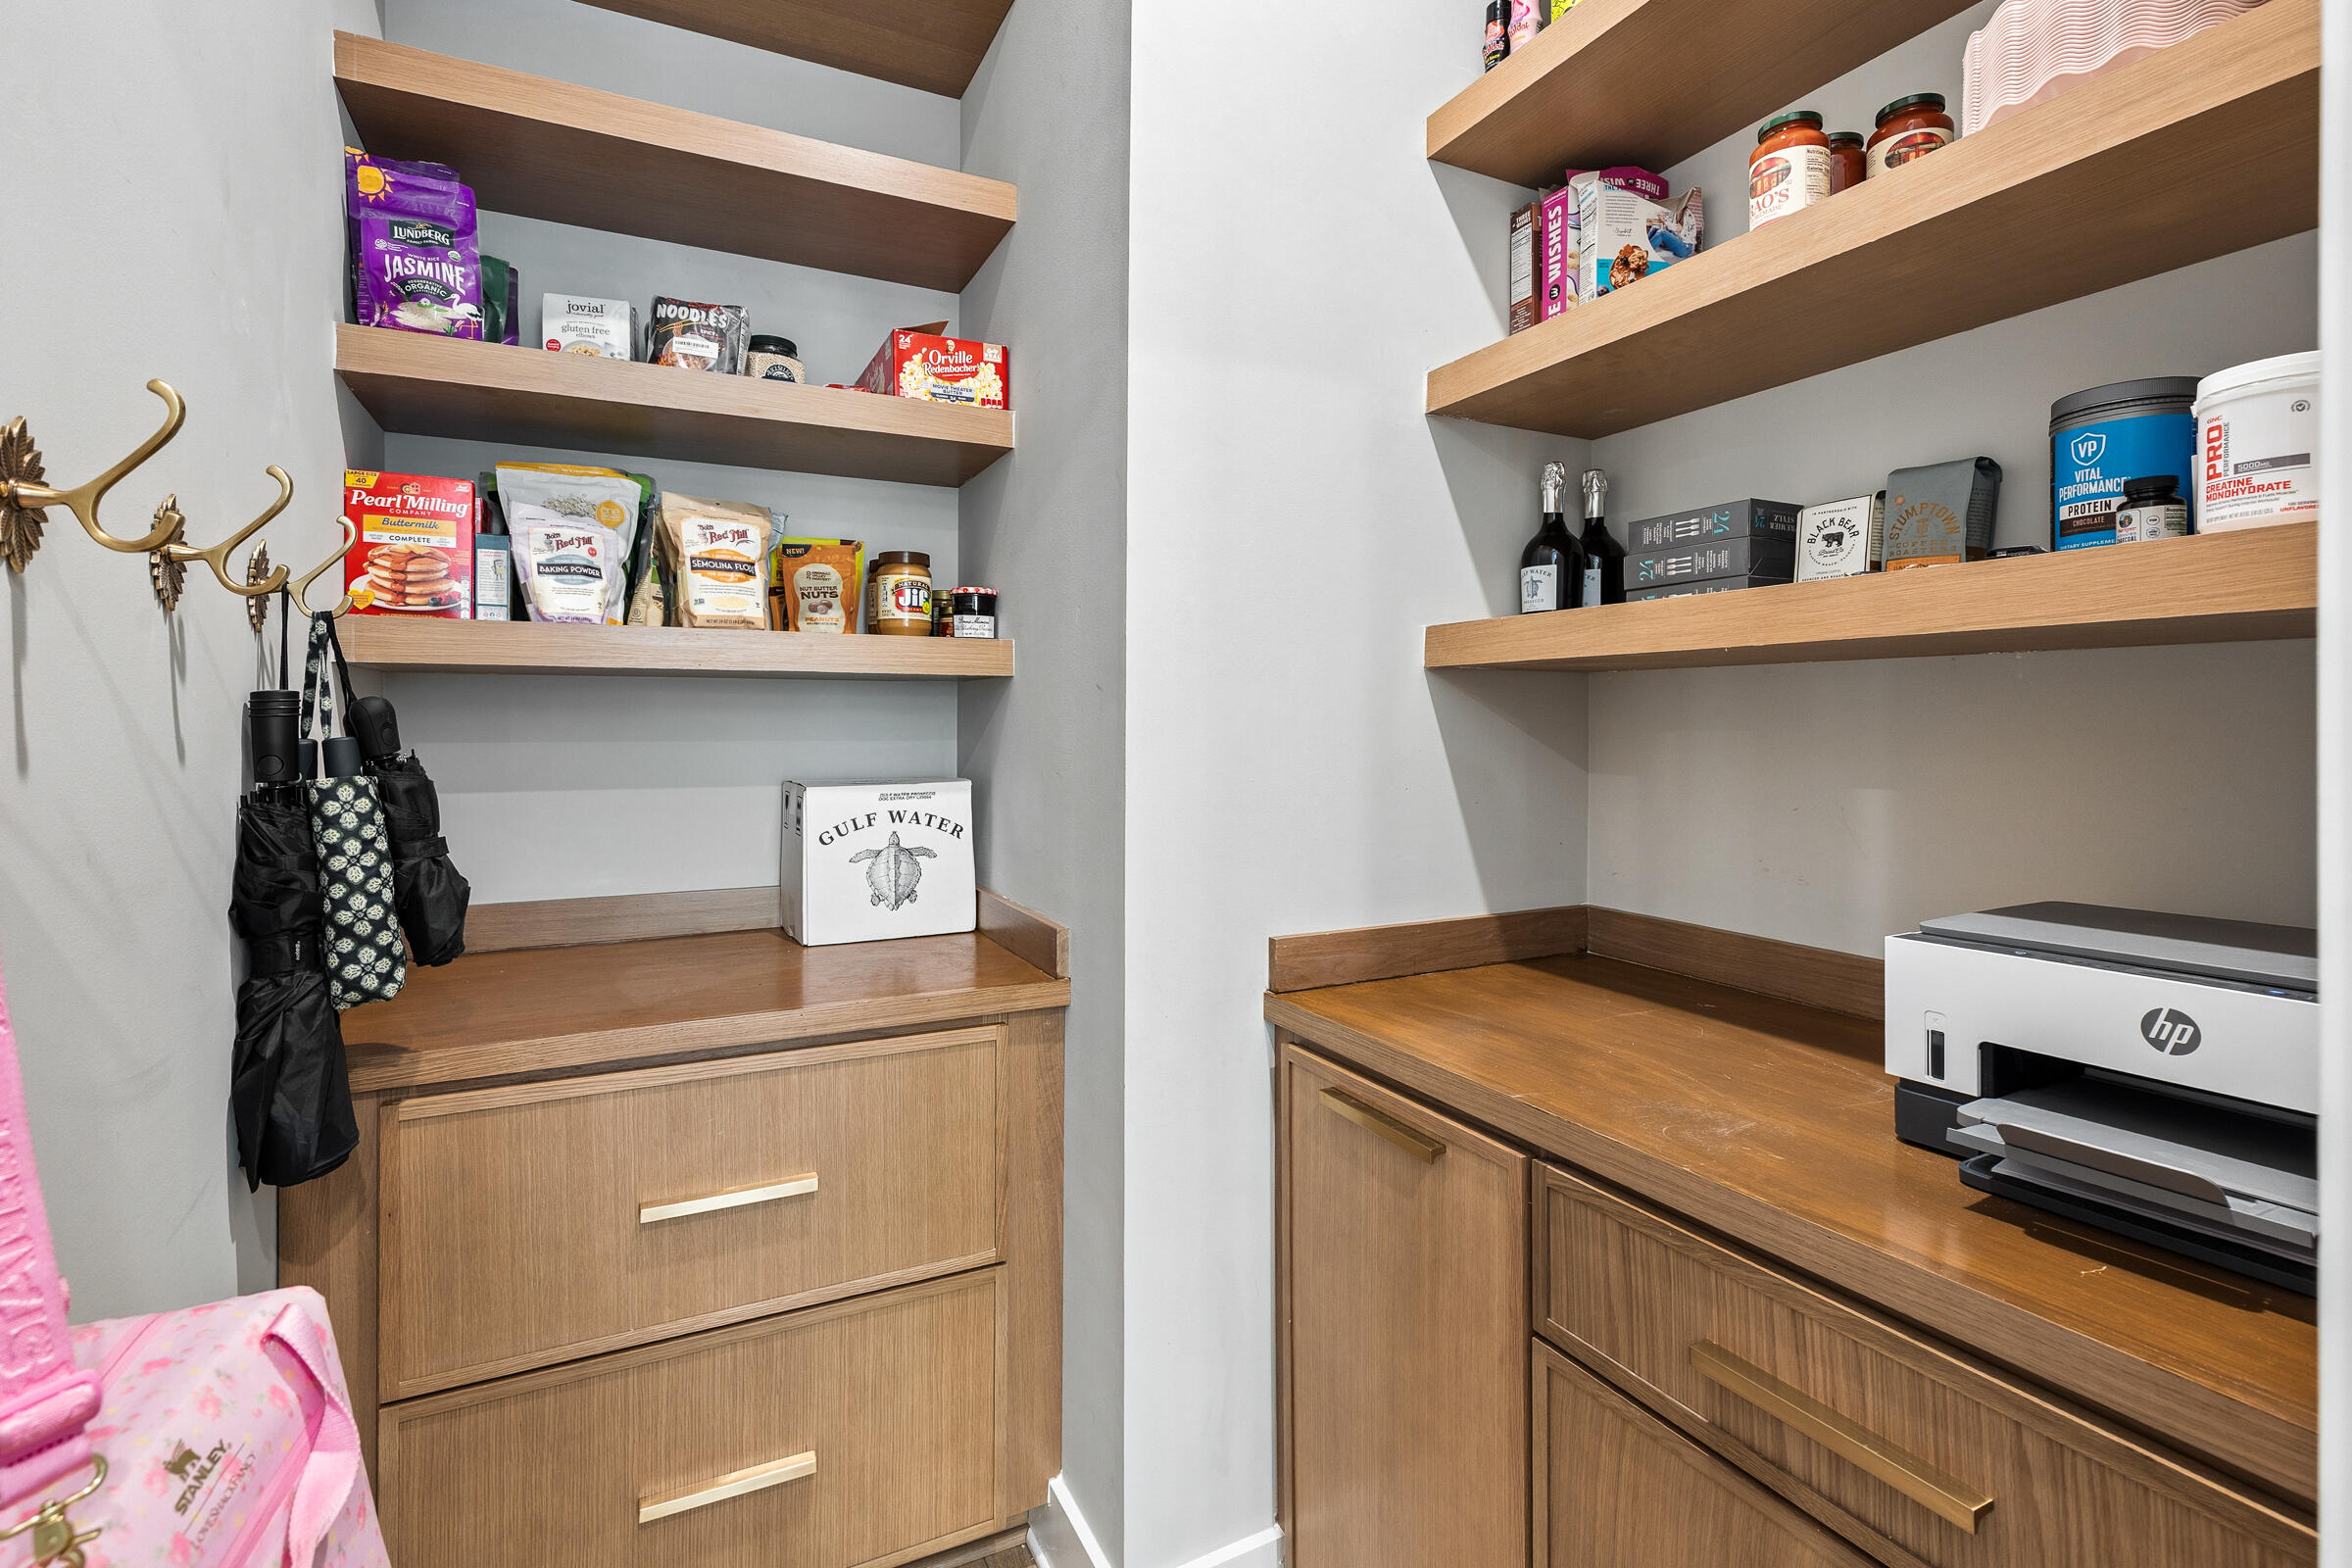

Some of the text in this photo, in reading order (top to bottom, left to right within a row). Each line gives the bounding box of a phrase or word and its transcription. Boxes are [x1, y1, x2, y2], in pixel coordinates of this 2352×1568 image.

[1636, 178, 1660, 196] THREE
[392, 225, 450, 245] LUNDBERG
[1548, 205, 1562, 284] WISHES
[384, 254, 466, 295] JASMINE
[405, 283, 447, 297] ORGANIC
[566, 300, 604, 314] jovial
[656, 303, 728, 329] NOODLES
[561, 324, 611, 336] gluten free
[899, 334, 911, 343] 24
[929, 349, 973, 365] Orville
[922, 362, 981, 376] Redenbacher's
[2206, 415, 2223, 424] GNC
[2078, 440, 2097, 458] VP
[2206, 424, 2223, 481] PRO
[2074, 466, 2103, 483] VITAL
[2205, 477, 2253, 494] CREATINE
[2205, 480, 2291, 502] MONOHYDRATE
[350, 489, 468, 518] Pearl Milling
[389, 508, 431, 516] COMPANY
[2068, 499, 2112, 517] PROTEIN
[382, 517, 439, 529] Buttermilk
[1714, 511, 1730, 534] 24
[1769, 522, 1796, 532] REMIER
[1889, 502, 1960, 540] STUMPTOWN
[2073, 516, 2105, 527] CHOCOLATE
[708, 529, 748, 545] Red Mill
[1807, 517, 1860, 544] BLACK BEAR
[389, 535, 431, 544] COMPLETE
[555, 536, 593, 551] Red Mill
[2081, 539, 2116, 547] SUPPLEME
[571, 566, 600, 577] POWDER
[692, 560, 733, 570] SEMOLINA
[1530, 569, 1552, 578] WATER
[1639, 560, 1654, 580] 24
[800, 591, 839, 600] NUTS
[898, 588, 929, 607] Jif
[819, 810, 964, 846] GULF WATER
[2148, 1007, 2195, 1055] hp
[174, 1439, 227, 1516] STANLEY
